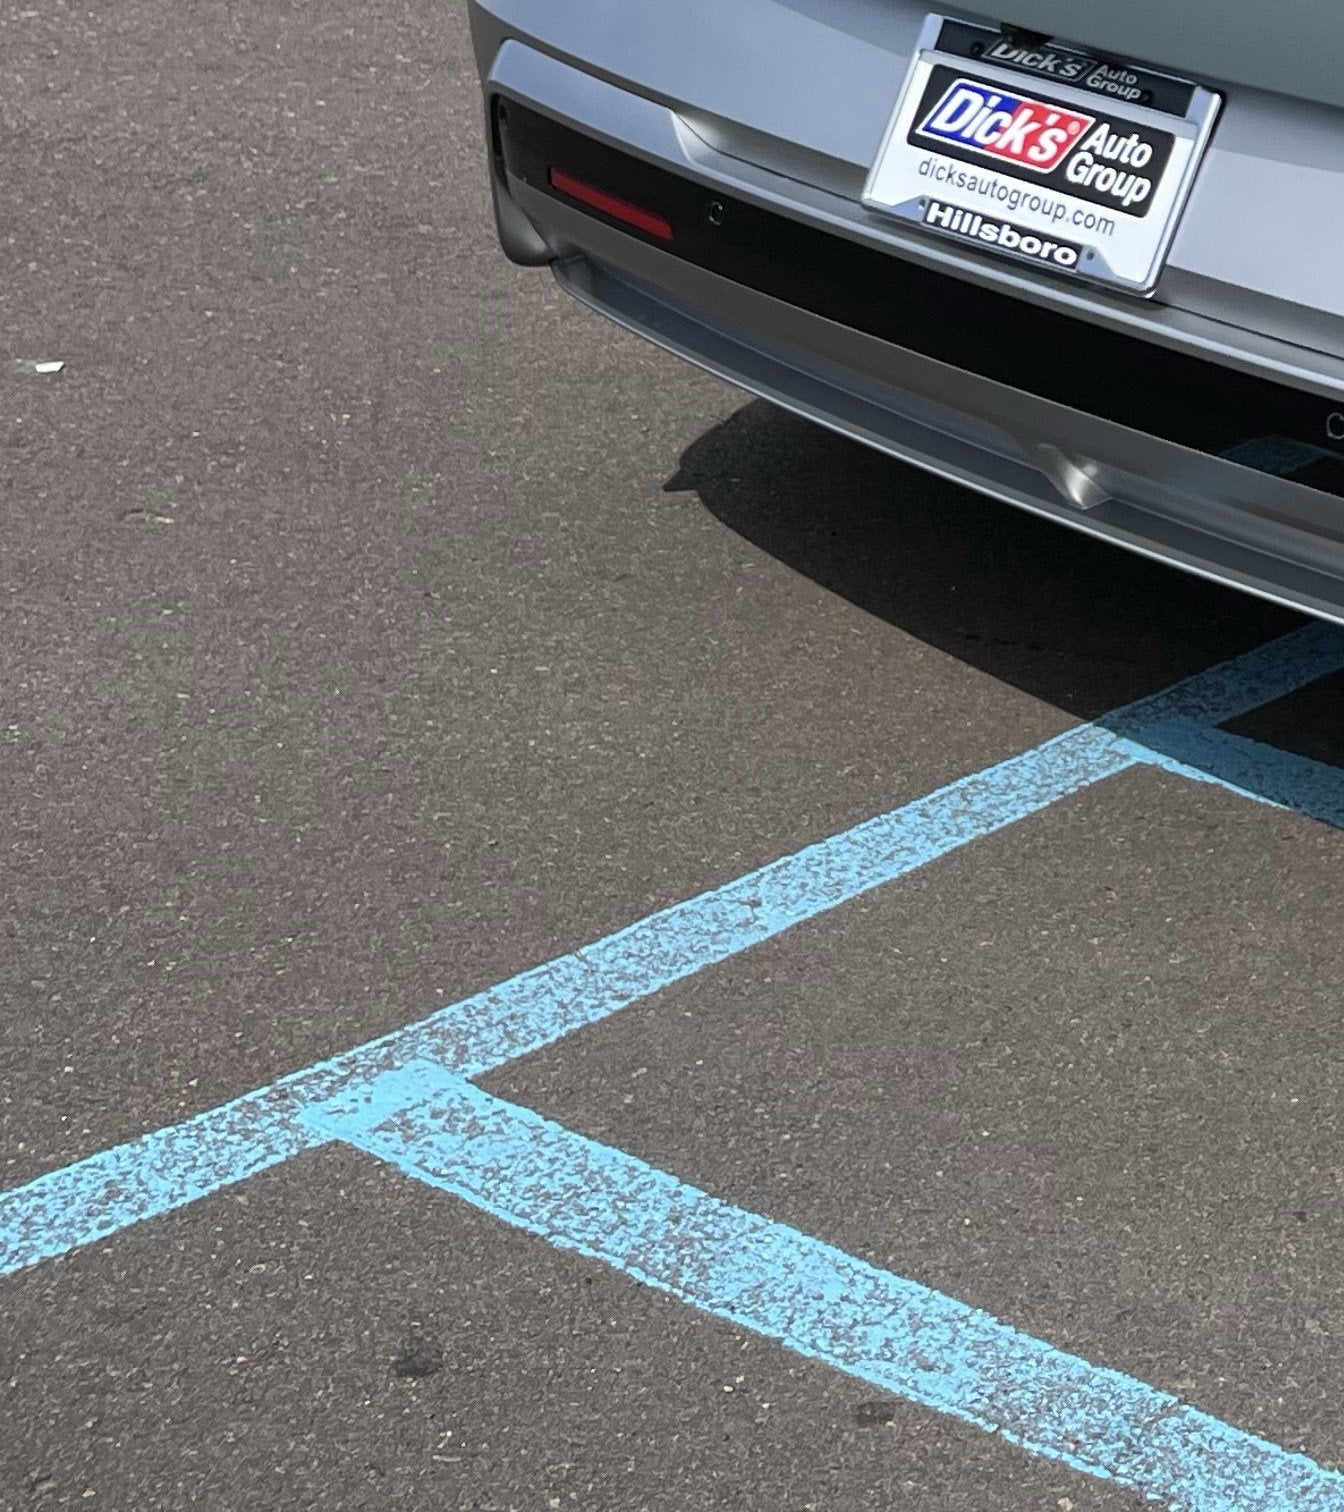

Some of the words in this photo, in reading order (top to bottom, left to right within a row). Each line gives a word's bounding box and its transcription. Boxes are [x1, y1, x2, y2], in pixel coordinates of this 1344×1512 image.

[1086, 74, 1142, 100] Group
[1095, 64, 1138, 85] Auto
[930, 86, 1069, 163] Dick's
[1079, 123, 1153, 168] Auto
[917, 156, 1116, 237] dicksautogroup.com
[1065, 152, 1153, 207] Group
[925, 201, 1079, 267] Hillsboro
